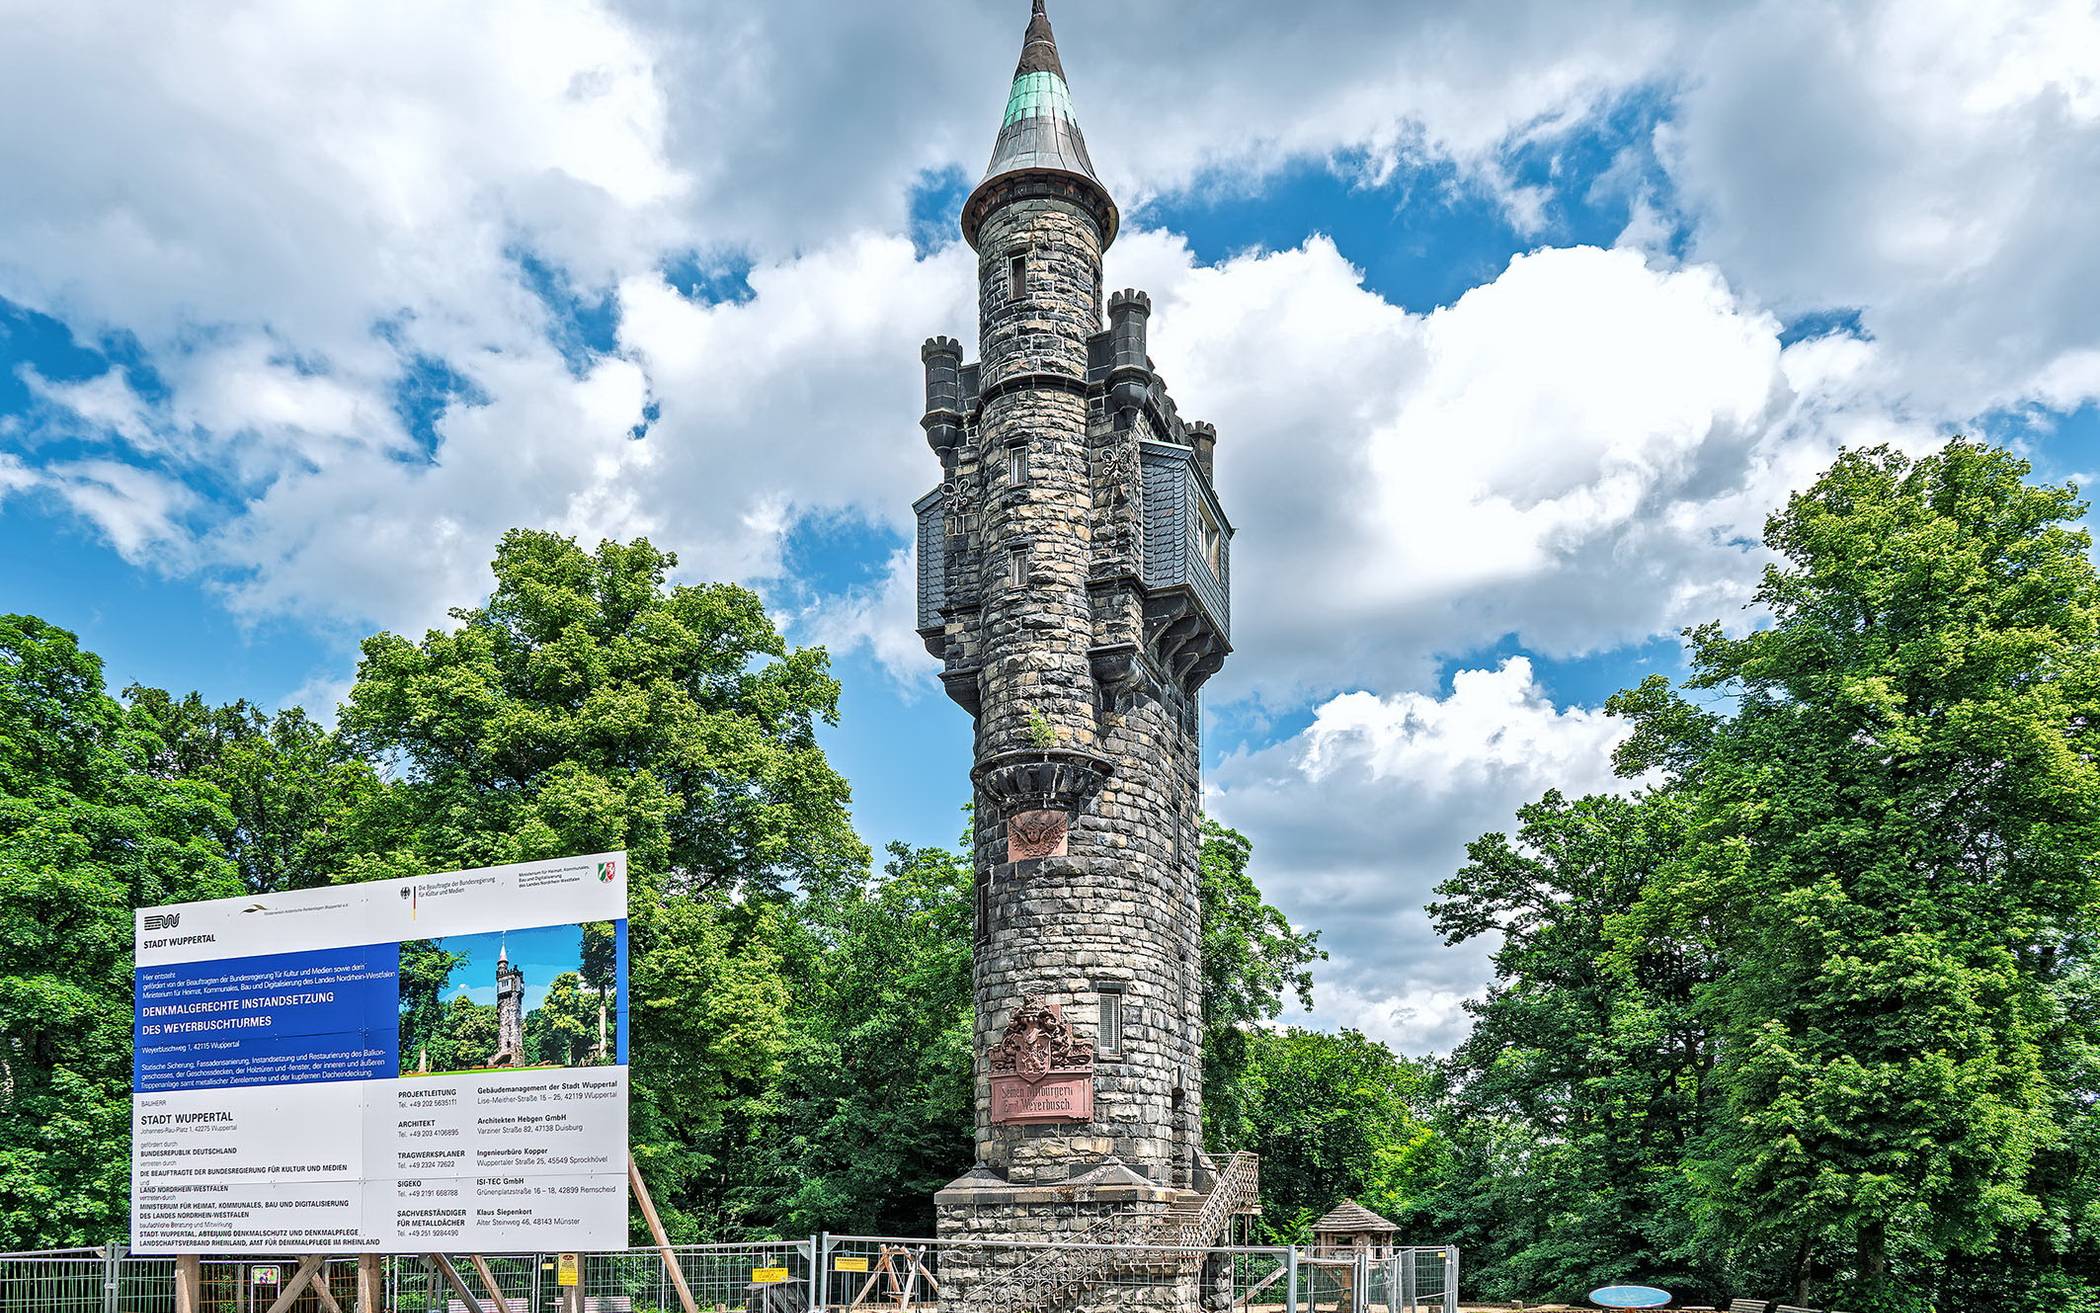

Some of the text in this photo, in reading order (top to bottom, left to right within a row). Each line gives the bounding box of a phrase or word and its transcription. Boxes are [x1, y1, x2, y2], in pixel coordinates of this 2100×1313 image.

[144, 934, 216, 949] STADT WUPPERTAL
[143, 980, 166, 991] gefördert
[186, 976, 219, 985] Beauftragten
[230, 972, 274, 982] Bundesregierung
[142, 992, 334, 1017] DENKMALGERECHTE INSTANDSETZUNG
[142, 1016, 272, 1035] DES WEYERBUSCHTURMES
[142, 1045, 186, 1055] Weyerbuschweg
[211, 1040, 240, 1050] Wuppertal
[141, 1063, 166, 1071] Statische
[167, 1060, 195, 1070] Sicherung,
[196, 1057, 250, 1067] Fassadensanierung,
[252, 1055, 295, 1064] Instandsetzung
[309, 1052, 349, 1060] Restaurierung
[363, 1048, 386, 1056] Balkon-
[141, 1080, 179, 1090] Treppenanlage
[195, 1077, 228, 1086] metallischer
[230, 1075, 267, 1084] Zierelemente
[322, 1069, 373, 1079] Dacheindeckung.
[478, 1084, 547, 1094] Gebäudemanagement
[582, 1080, 617, 1090] Wuppertal
[398, 1089, 456, 1098] PROJEKTLEITUNG
[553, 1094, 562, 1102] 25,
[584, 1091, 617, 1100] Wuppertal
[141, 1112, 233, 1125] STADT WUPPERTAL
[517, 1115, 542, 1124] Hebgen
[523, 1126, 533, 1134] 82,
[555, 1124, 583, 1132] Duisburg
[398, 1150, 465, 1159] TRAGWERKSPLANER
[477, 1148, 548, 1157] Ingenieurbüro Kopper
[477, 1159, 513, 1168] Wuppertaler
[536, 1158, 546, 1166] 25,
[569, 1156, 608, 1165] Sprockhövel
[151, 1169, 192, 1177] BEAUFTRAGTE
[208, 1166, 266, 1175] BUNDESREGIERUNG
[268, 1164, 280, 1173] FÜR
[157, 1184, 229, 1193] NORDRHEIN-WESTFALEN
[548, 1187, 557, 1196] 18,
[180, 1201, 192, 1209] FÜR
[193, 1202, 217, 1210] HEIMAT,
[218, 1201, 263, 1210] KOMMUNALES,
[177, 1211, 249, 1219] NORDRHEIN-WESTFALEN
[397, 1208, 466, 1217] SACHVERSTÄNDIGER
[412, 1218, 465, 1226] METALLDÄCHER
[492, 1219, 520, 1227] Steinweg
[521, 1218, 532, 1227] 46,
[160, 1230, 197, 1239] WUPPERTAL,
[211, 1239, 248, 1248] RHEINLAND,
[265, 1238, 277, 1246] FÜR
